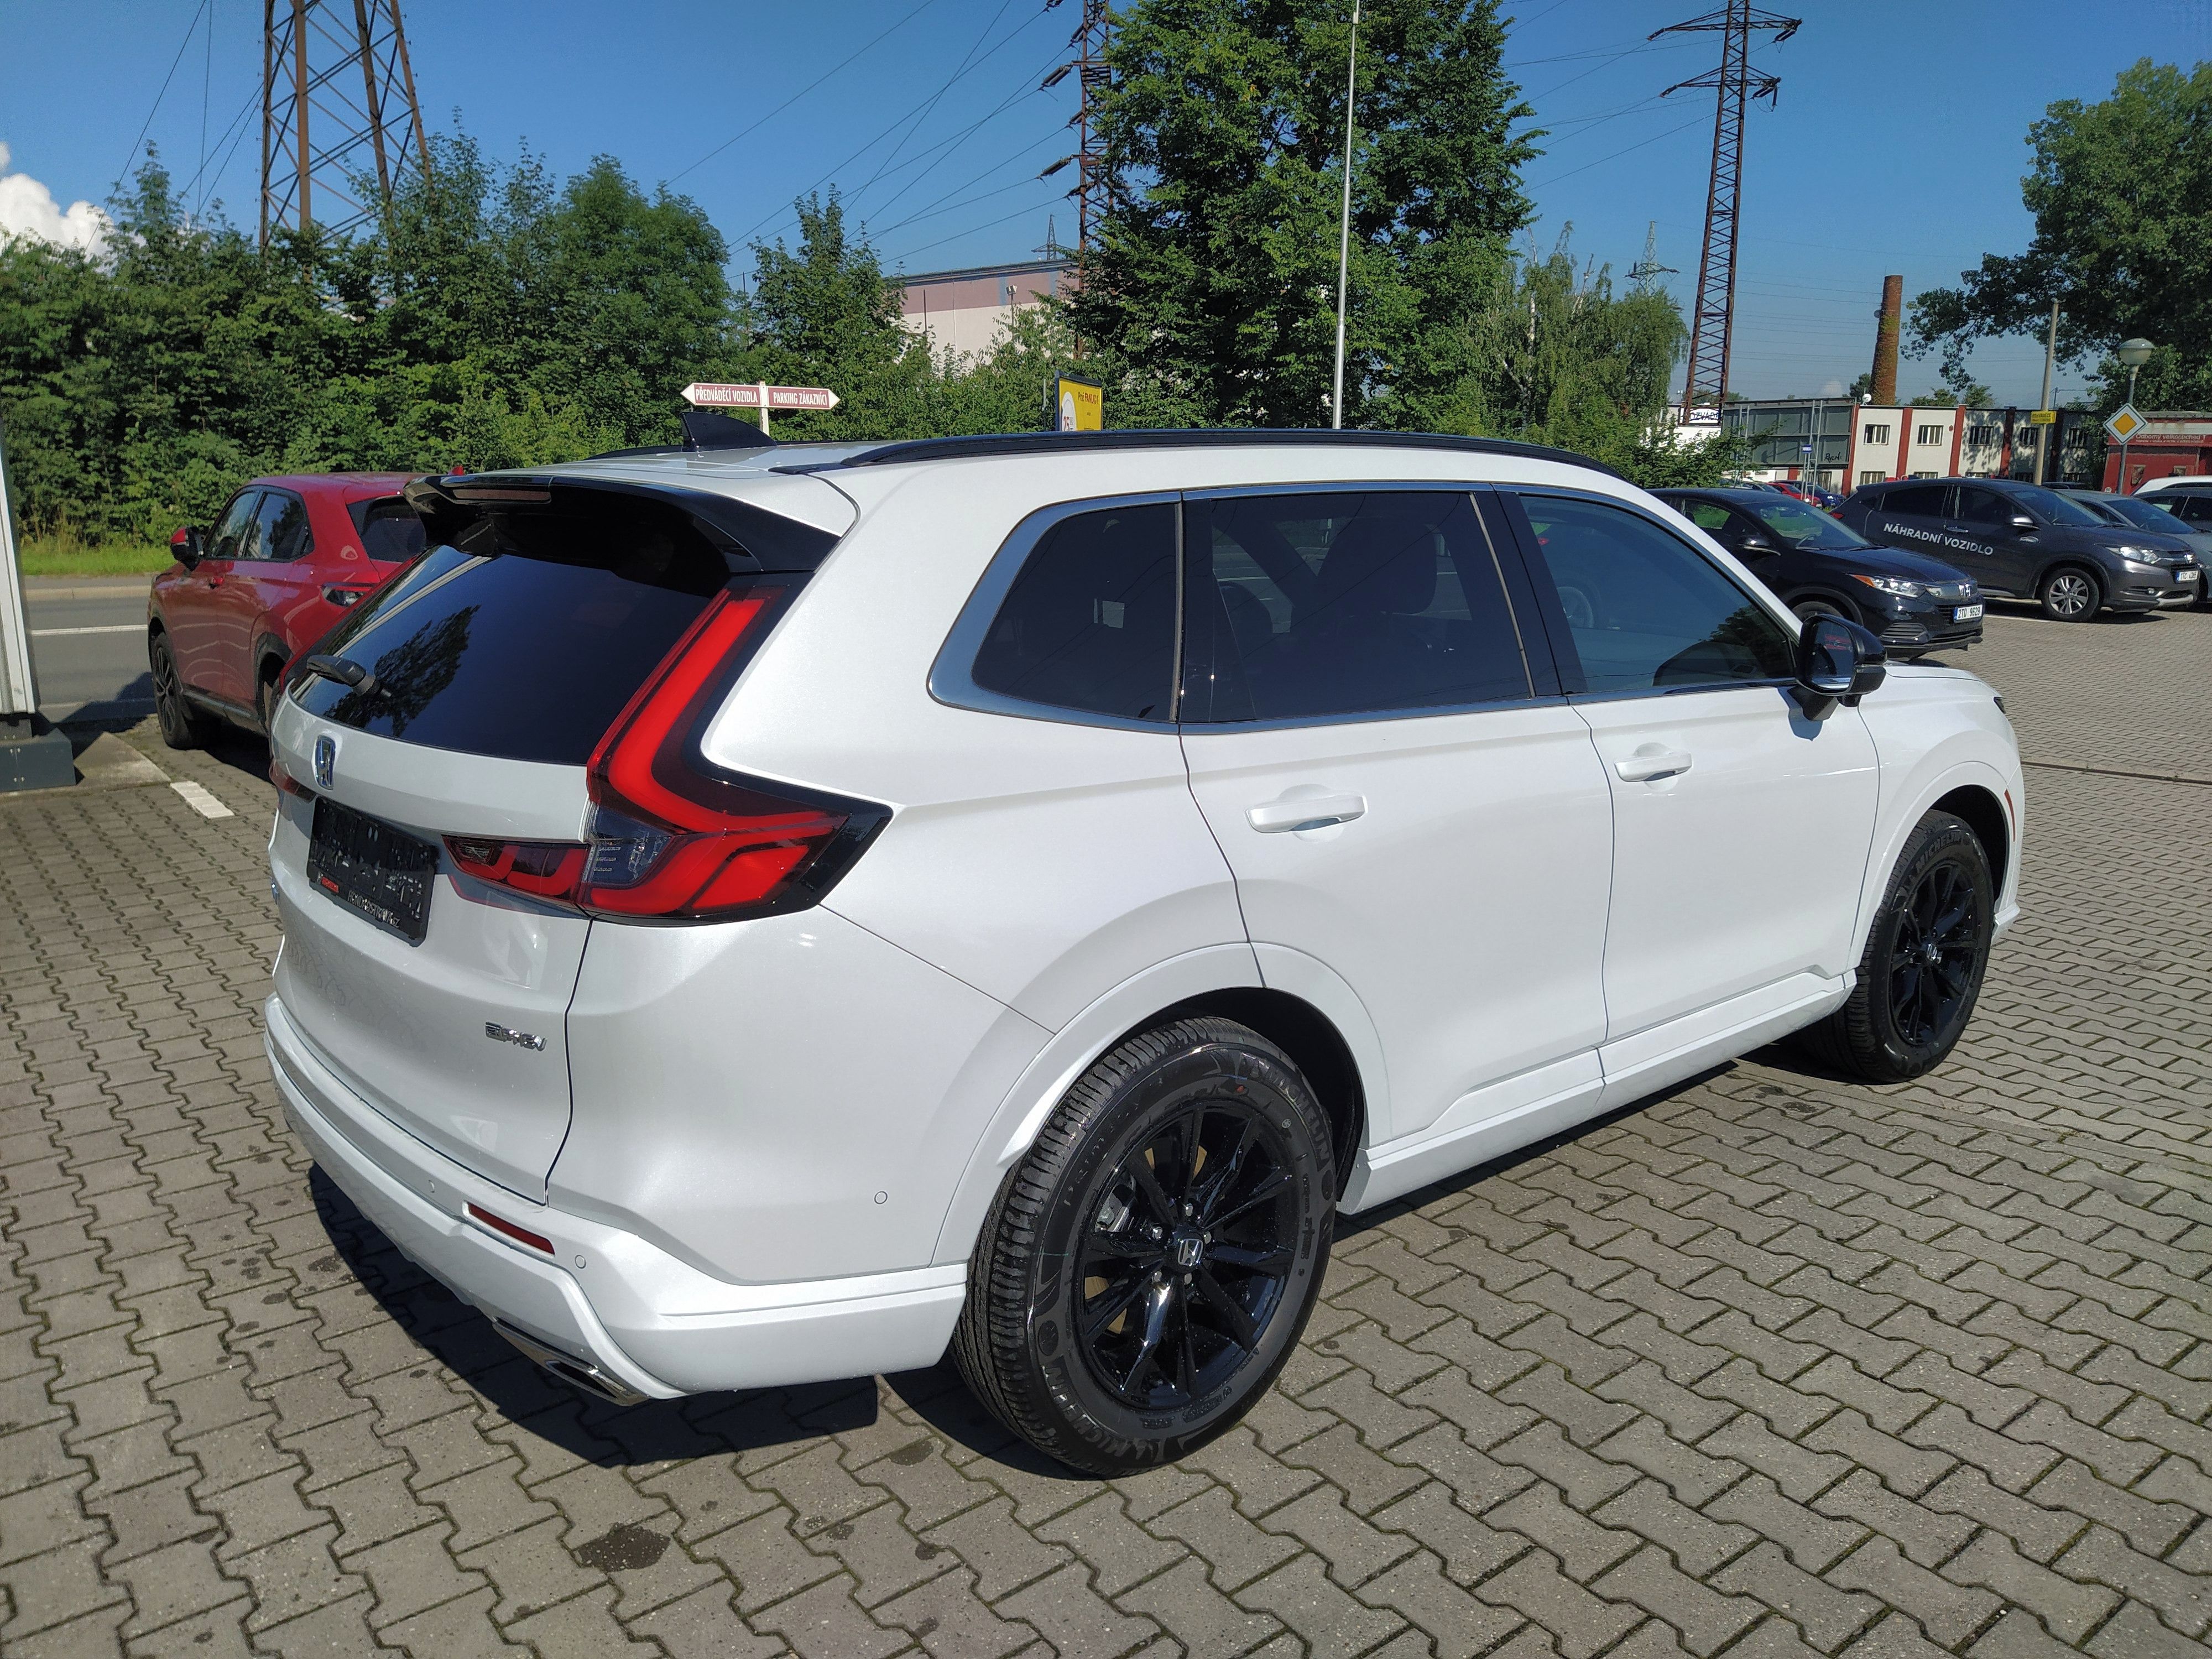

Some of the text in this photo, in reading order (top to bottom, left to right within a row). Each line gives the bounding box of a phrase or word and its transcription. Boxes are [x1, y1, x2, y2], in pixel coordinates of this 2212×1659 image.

[695, 387, 758, 403] PŘEDVÁDĚCÍ VOZIDLA
[773, 390, 827, 405] PARKING ZÁKAZNÍCI
[1884, 523, 1994, 555] NÁHRADNÍ VOZIDLO
[1958, 606, 1980, 619] 2TD 9629
[1266, 1066, 1330, 1160] MICHELIN
[1042, 1365, 1131, 1457] MICHELIN
